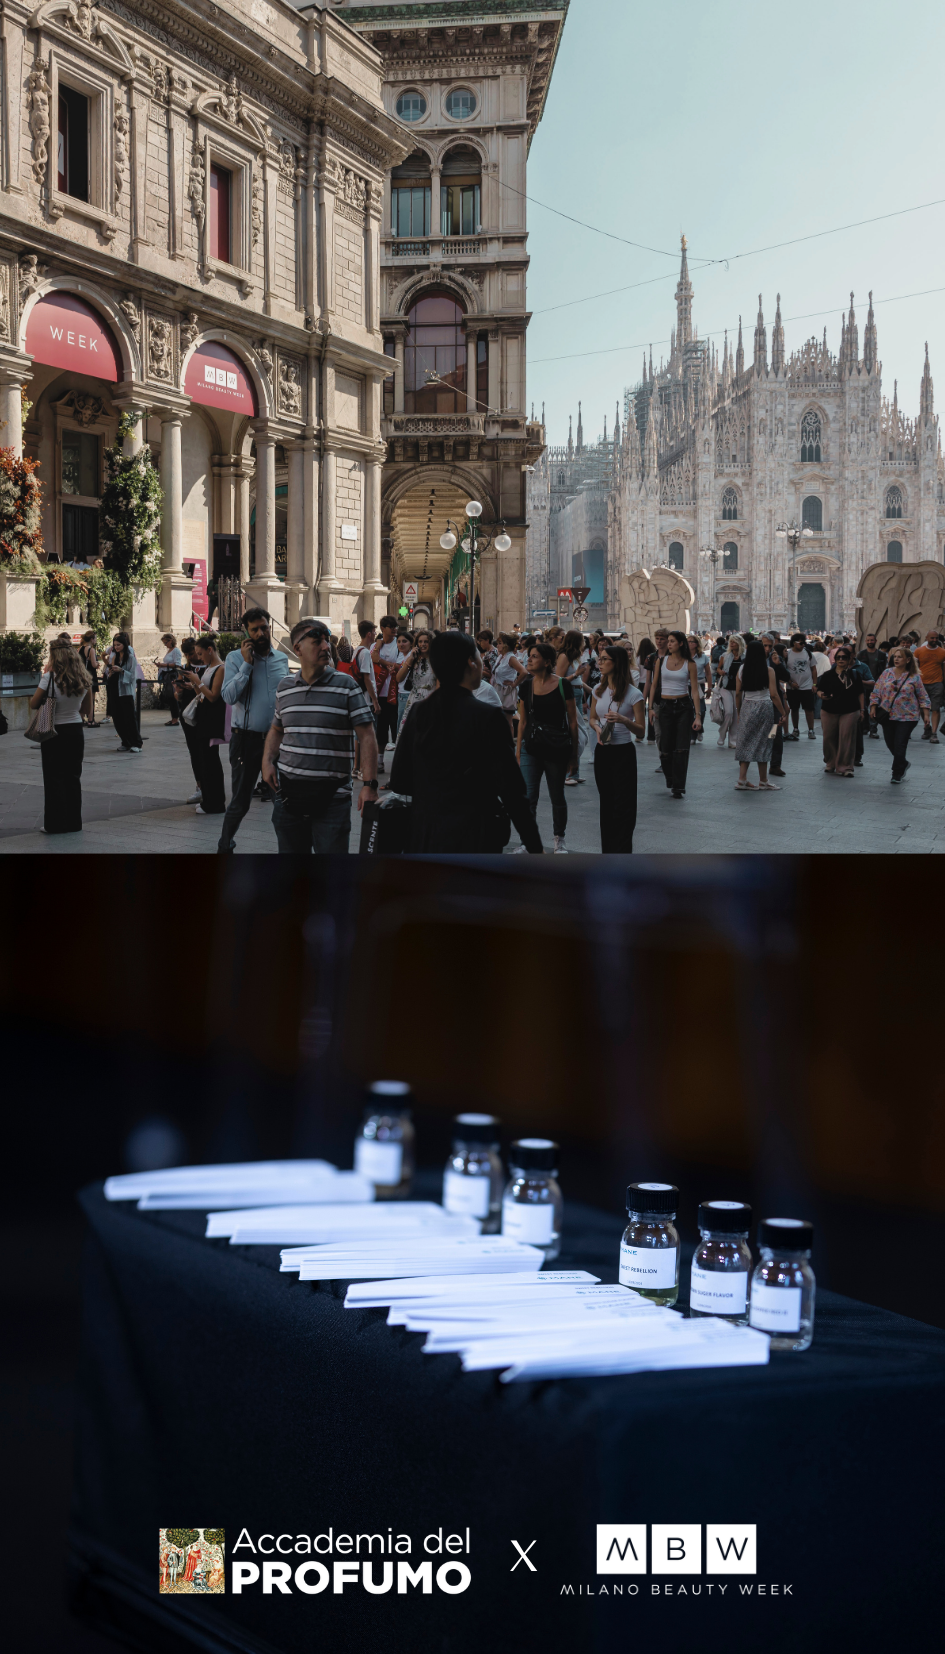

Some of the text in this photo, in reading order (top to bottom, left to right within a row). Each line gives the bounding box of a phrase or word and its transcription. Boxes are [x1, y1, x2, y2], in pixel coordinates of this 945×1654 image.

[50, 325, 98, 352] WEEK
[367, 821, 378, 854] SCENTE
[630, 1266, 658, 1274] REBELLION
